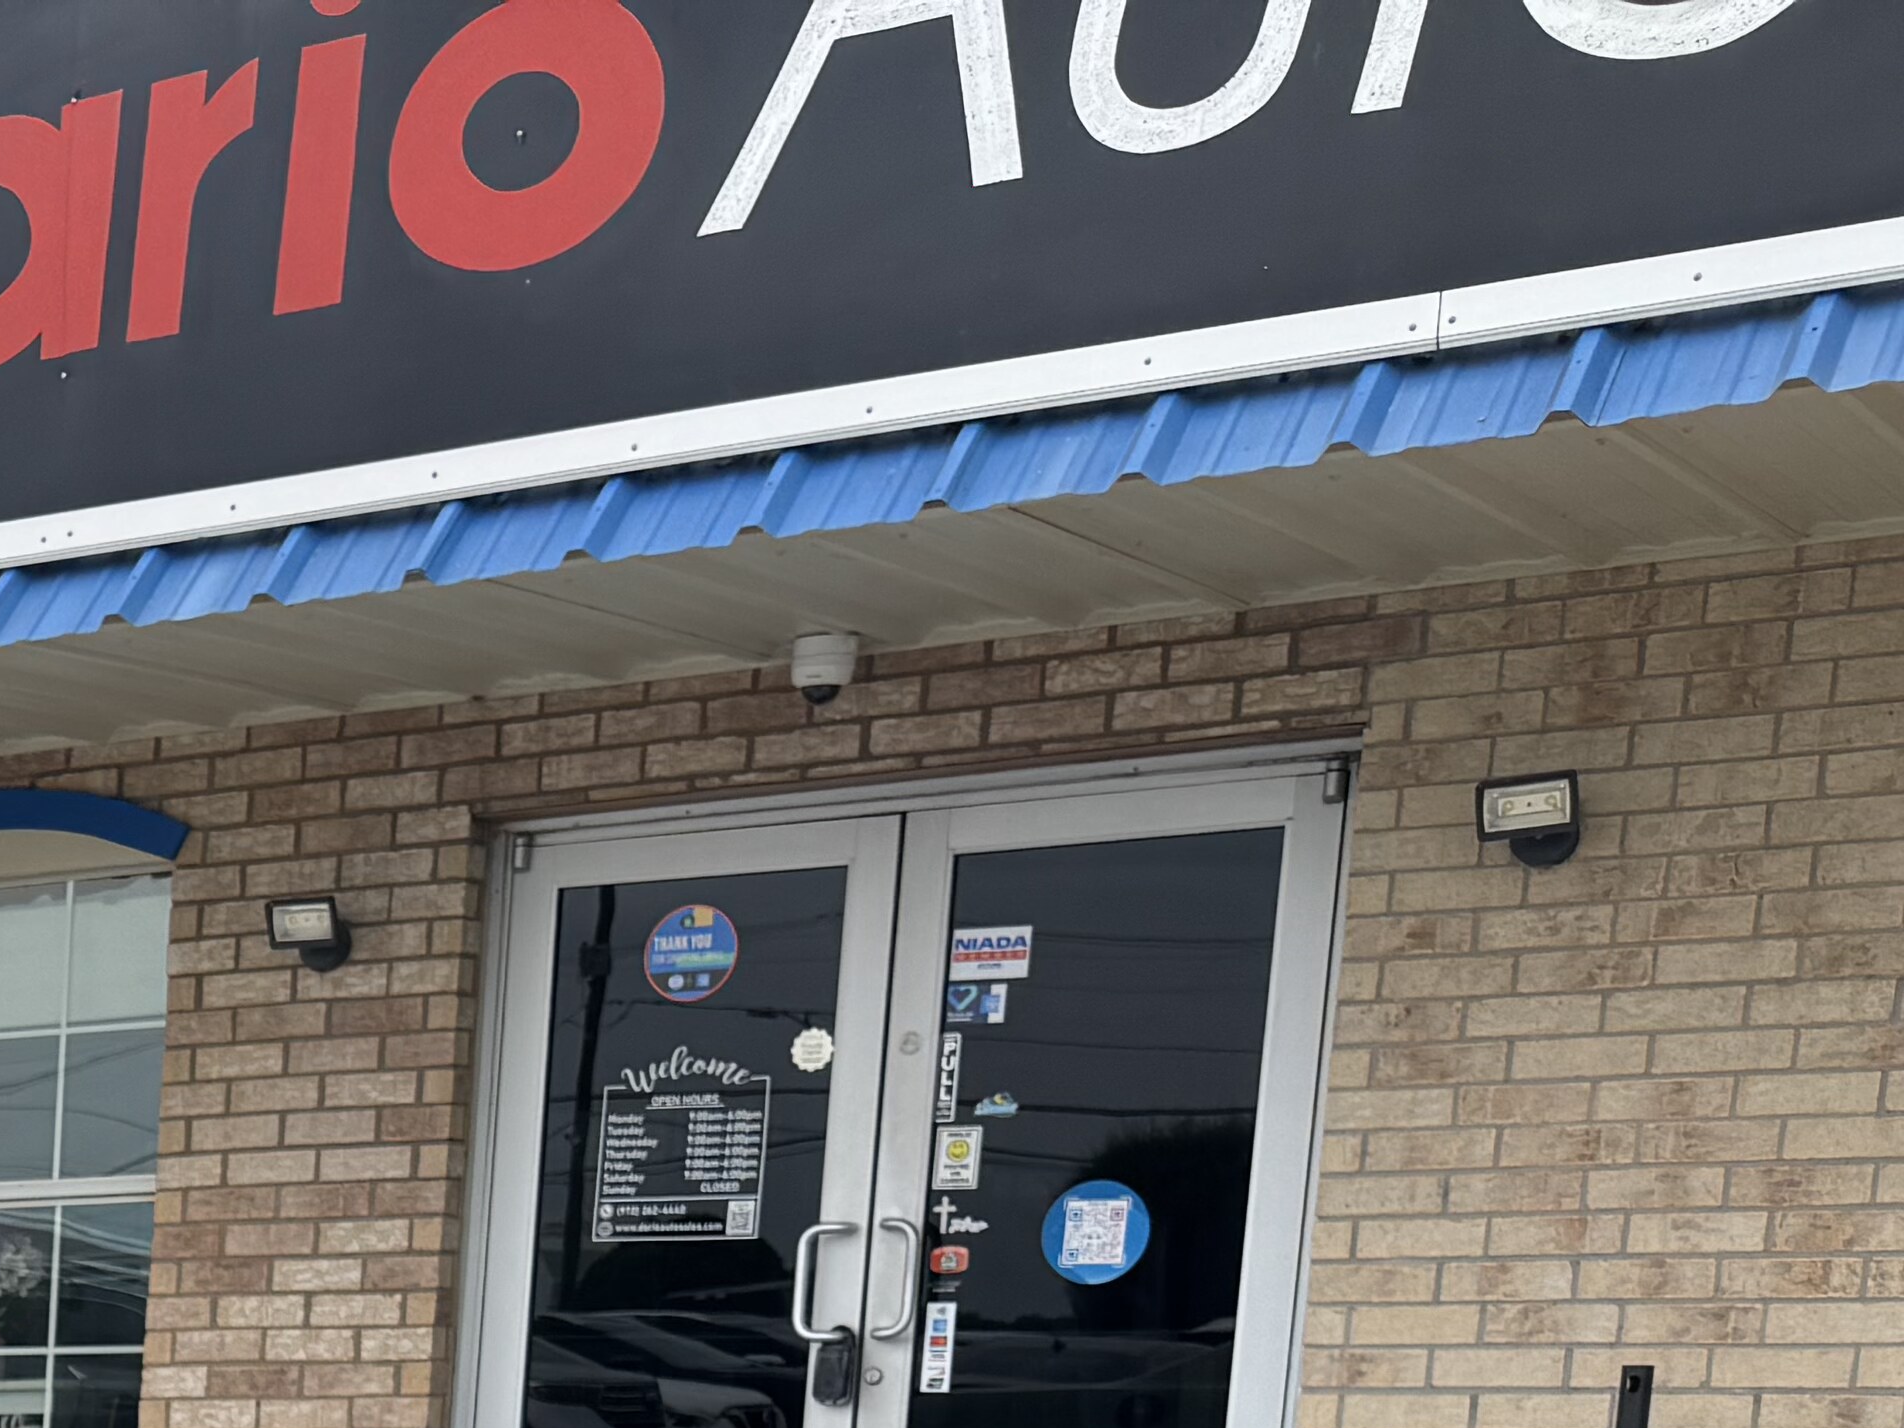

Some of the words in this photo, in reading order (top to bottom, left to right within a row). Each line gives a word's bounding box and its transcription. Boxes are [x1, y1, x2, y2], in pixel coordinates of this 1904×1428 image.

[654, 935, 689, 951] THANK
[691, 933, 713, 949] YOU
[955, 936, 1028, 951] NIADA
[621, 1045, 750, 1093] Welcome
[939, 1042, 958, 1101] PULL
[651, 1095, 681, 1106] OPEN
[682, 1093, 720, 1105] HOURS
[607, 1114, 645, 1125] Monday
[607, 1126, 646, 1137] Tuesday
[606, 1138, 658, 1149] Wednesday
[605, 1150, 648, 1161] Thursday
[604, 1161, 634, 1172] Friday
[603, 1173, 645, 1184] Saturday
[602, 1184, 637, 1196] Sunday
[700, 1181, 740, 1193] CLOSED
